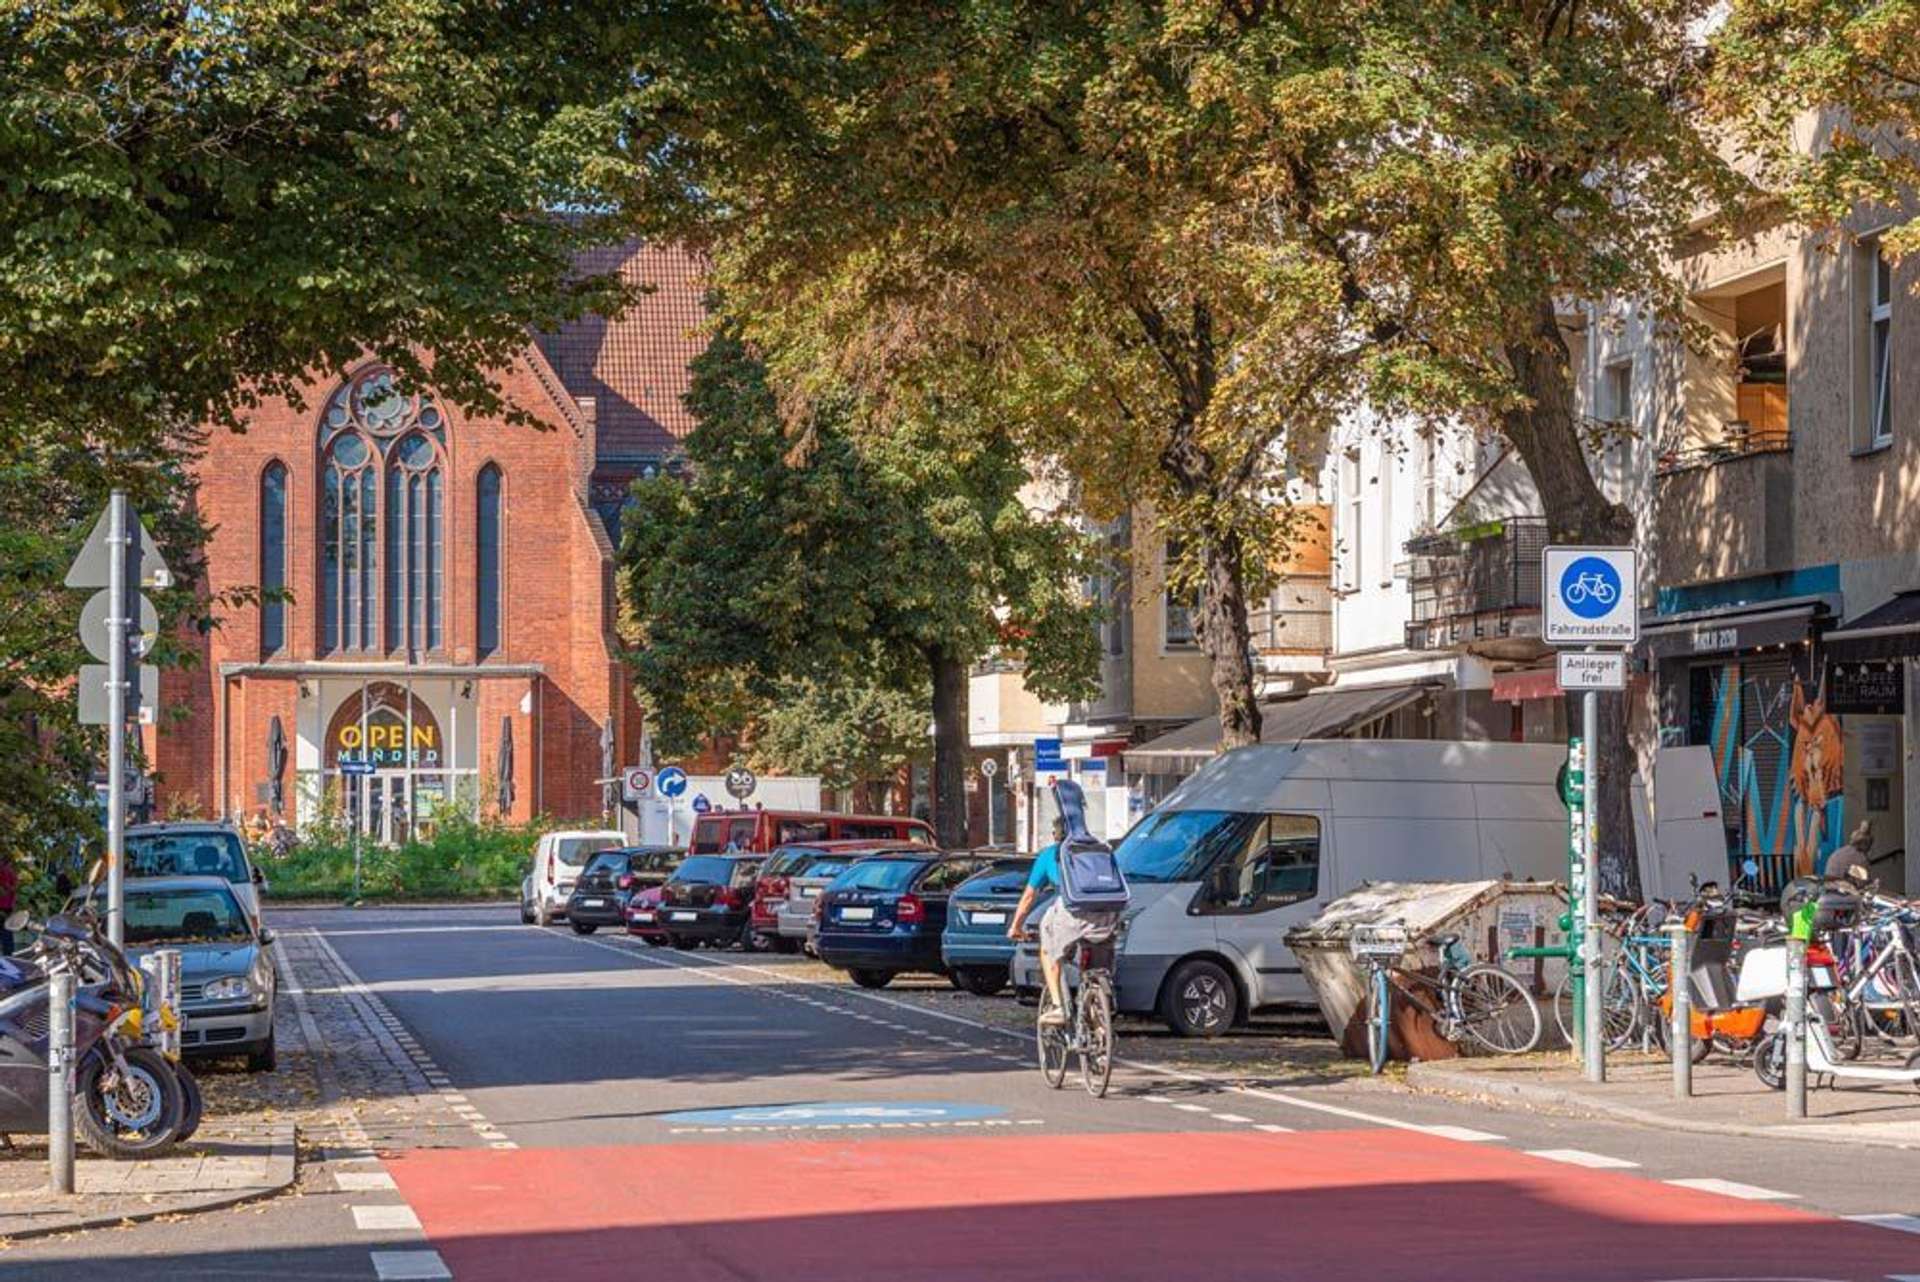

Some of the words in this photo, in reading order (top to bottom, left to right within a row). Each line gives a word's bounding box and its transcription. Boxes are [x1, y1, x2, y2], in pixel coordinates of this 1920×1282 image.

[1551, 624, 1632, 634] Fahrradstraße
[1567, 658, 1617, 673] Anlieger
[1582, 671, 1602, 682] frei
[1860, 686, 1897, 697] RAUM
[339, 726, 433, 748] OPEN
[338, 750, 437, 761] MINDED
